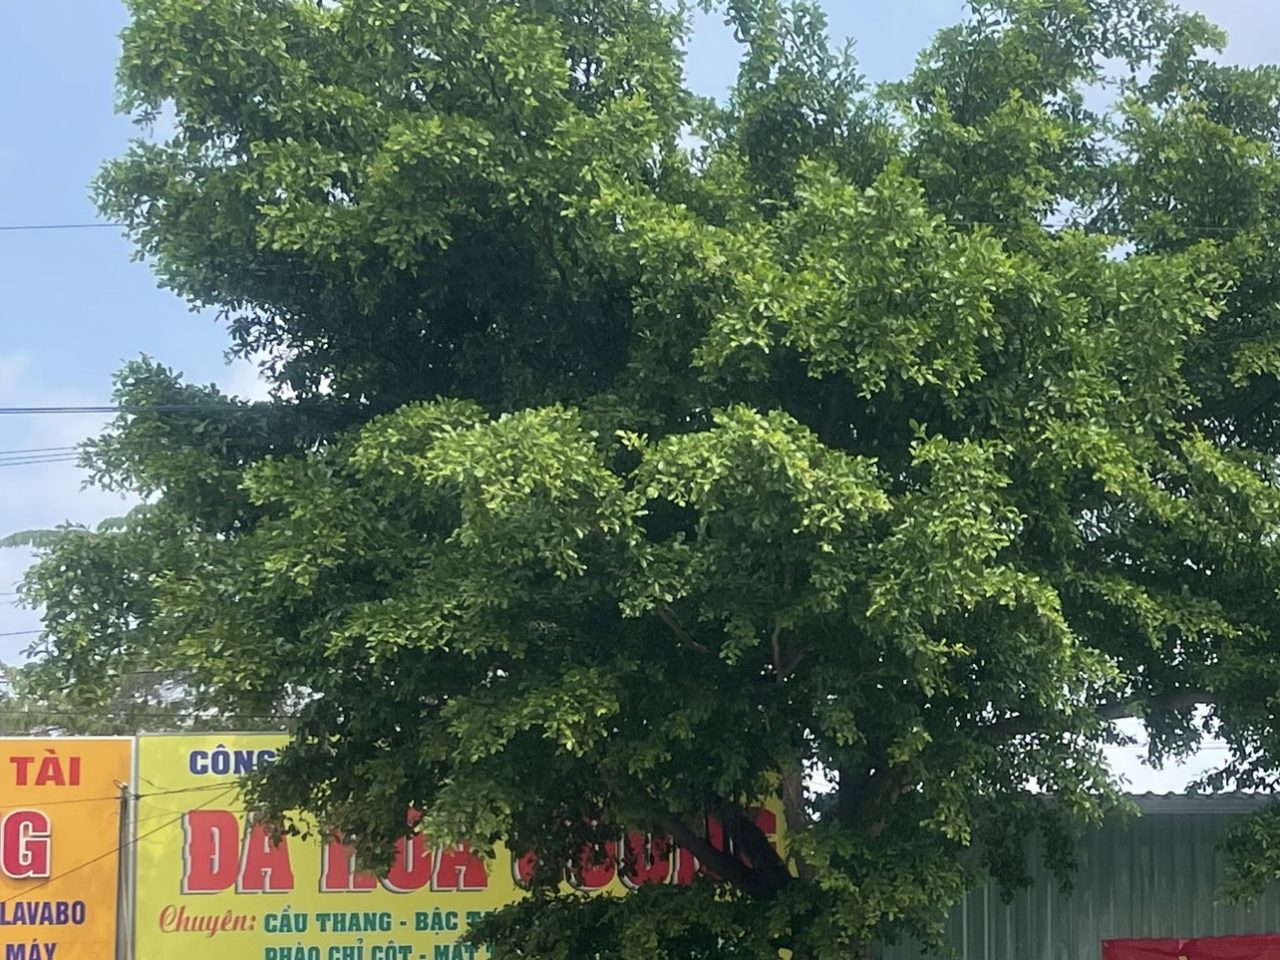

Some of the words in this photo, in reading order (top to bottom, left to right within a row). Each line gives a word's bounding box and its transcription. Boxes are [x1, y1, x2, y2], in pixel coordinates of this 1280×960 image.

[9, 748, 81, 786] TÀI
[0, 900, 85, 925] LAVABO
[159, 904, 256, 938] Chuyên:
[316, 912, 392, 933] THANG
[415, 907, 459, 936] BẬC
